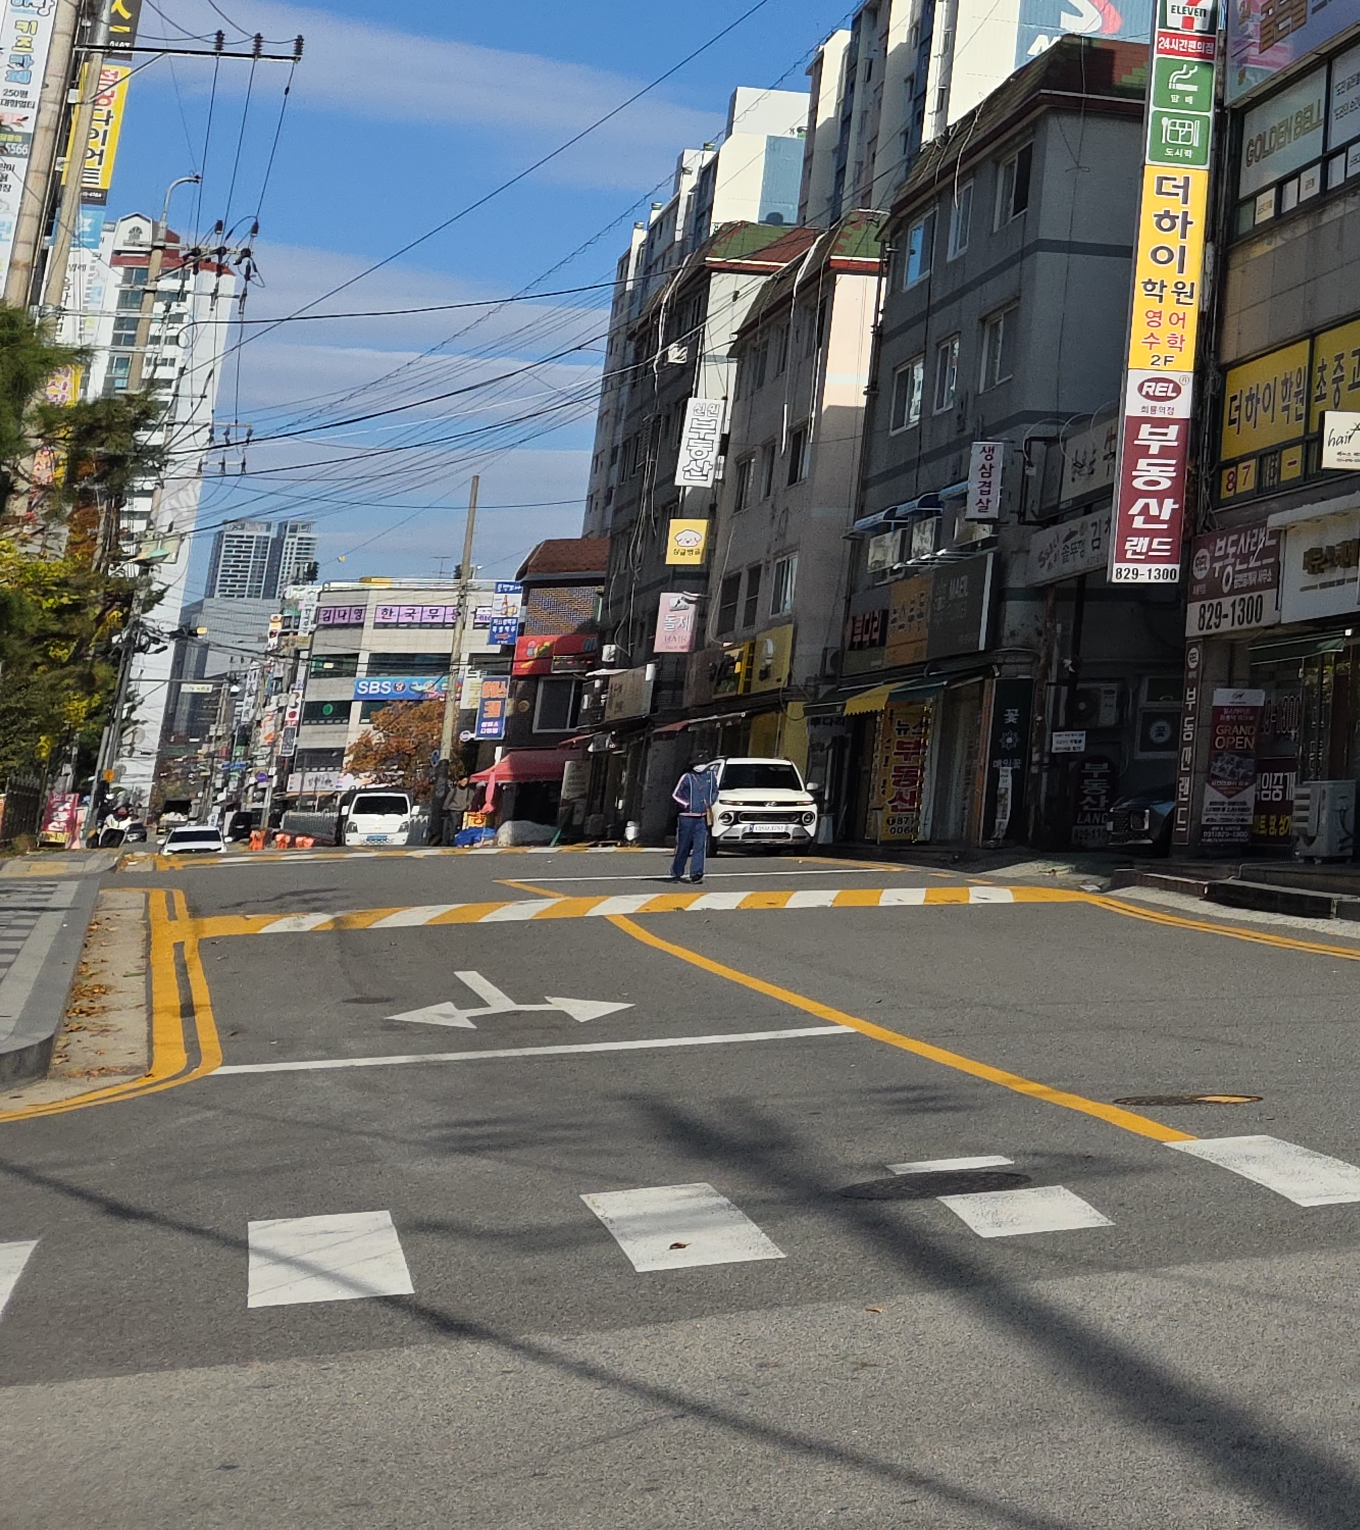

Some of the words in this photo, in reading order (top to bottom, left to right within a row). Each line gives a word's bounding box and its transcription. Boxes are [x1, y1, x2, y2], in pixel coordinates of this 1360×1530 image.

[1149, 175, 1194, 275] 더하이
[1141, 278, 1195, 307] 학원
[1144, 309, 1187, 331] 영어
[1141, 332, 1186, 353] 수학
[1150, 354, 1175, 367] 2F
[1141, 382, 1178, 398] REL
[1228, 376, 1277, 436] 더하이
[682, 418, 724, 482] 부동산
[975, 446, 996, 514] 생삼겹살
[1131, 424, 1181, 530] 부동산
[1124, 536, 1173, 560] 랜드
[1115, 567, 1177, 581] 829-1300
[1198, 594, 1265, 631] 829-1300
[357, 680, 393, 695] SBS
[1216, 725, 1256, 736] GRAND
[1214, 736, 1255, 750] OPEN
